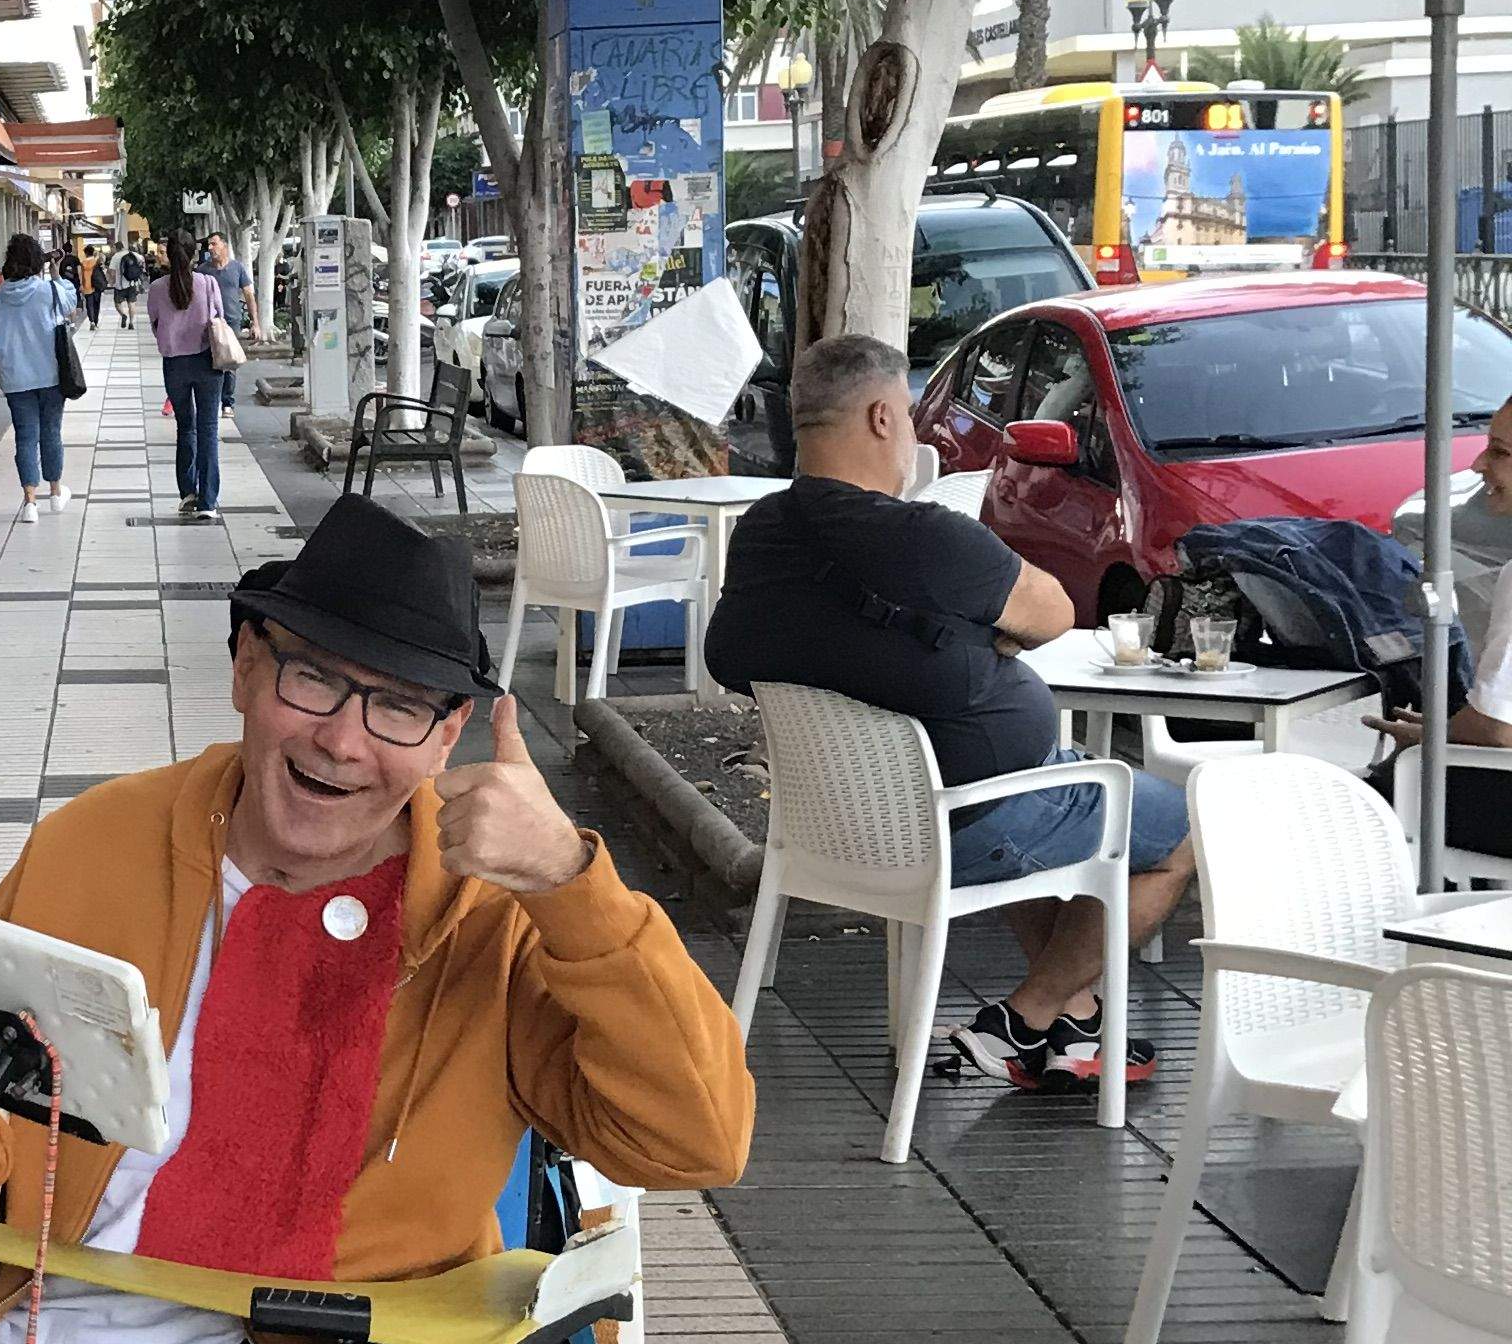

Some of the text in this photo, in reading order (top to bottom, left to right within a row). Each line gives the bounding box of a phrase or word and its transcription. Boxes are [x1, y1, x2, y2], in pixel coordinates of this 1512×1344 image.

[1141, 109, 1169, 123] 801
[1249, 141, 1266, 156] Al
[585, 280, 631, 292] FUERA
[585, 295, 603, 306] DE
